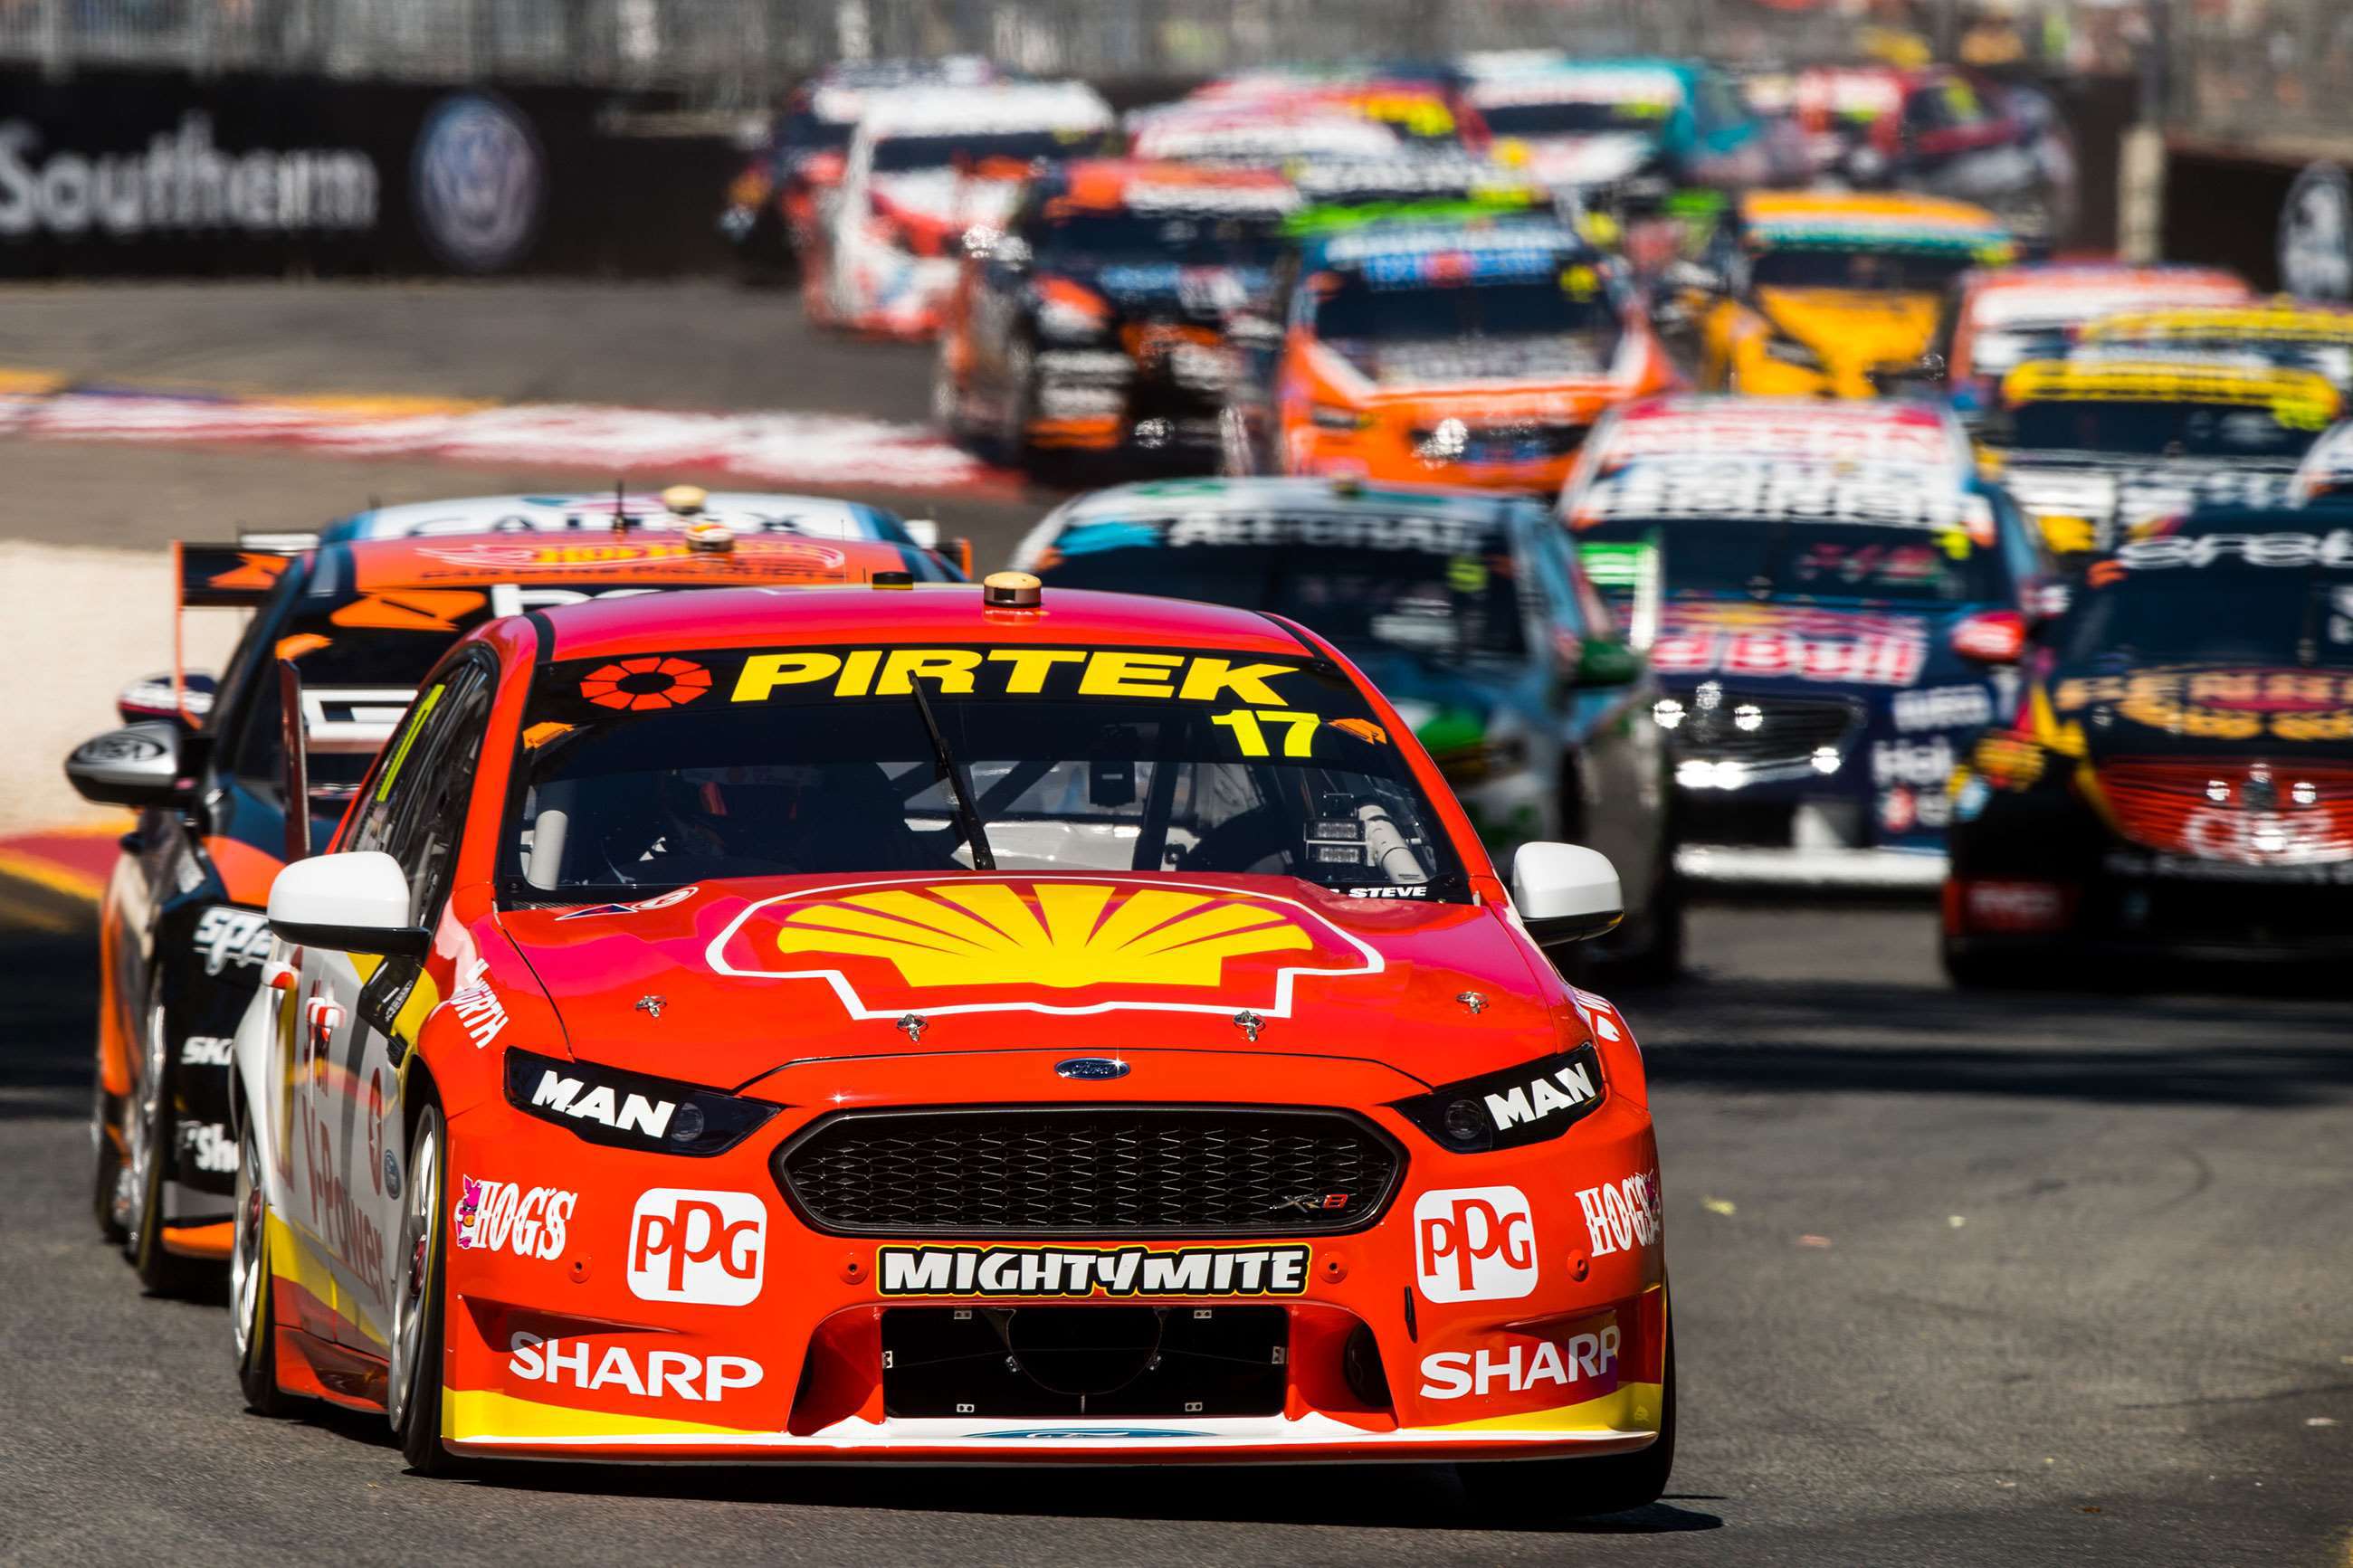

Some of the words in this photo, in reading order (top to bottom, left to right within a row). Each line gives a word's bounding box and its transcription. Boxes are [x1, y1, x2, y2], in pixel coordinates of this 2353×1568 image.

[730, 649, 1300, 706] PIRTEK
[1212, 709, 1320, 757] 17
[1348, 886, 1427, 898] STEVE
[531, 1069, 676, 1138] MAN
[1484, 1062, 1596, 1131] MAN
[509, 1331, 764, 1402] SHARP
[1419, 1325, 1622, 1400] SHARP
